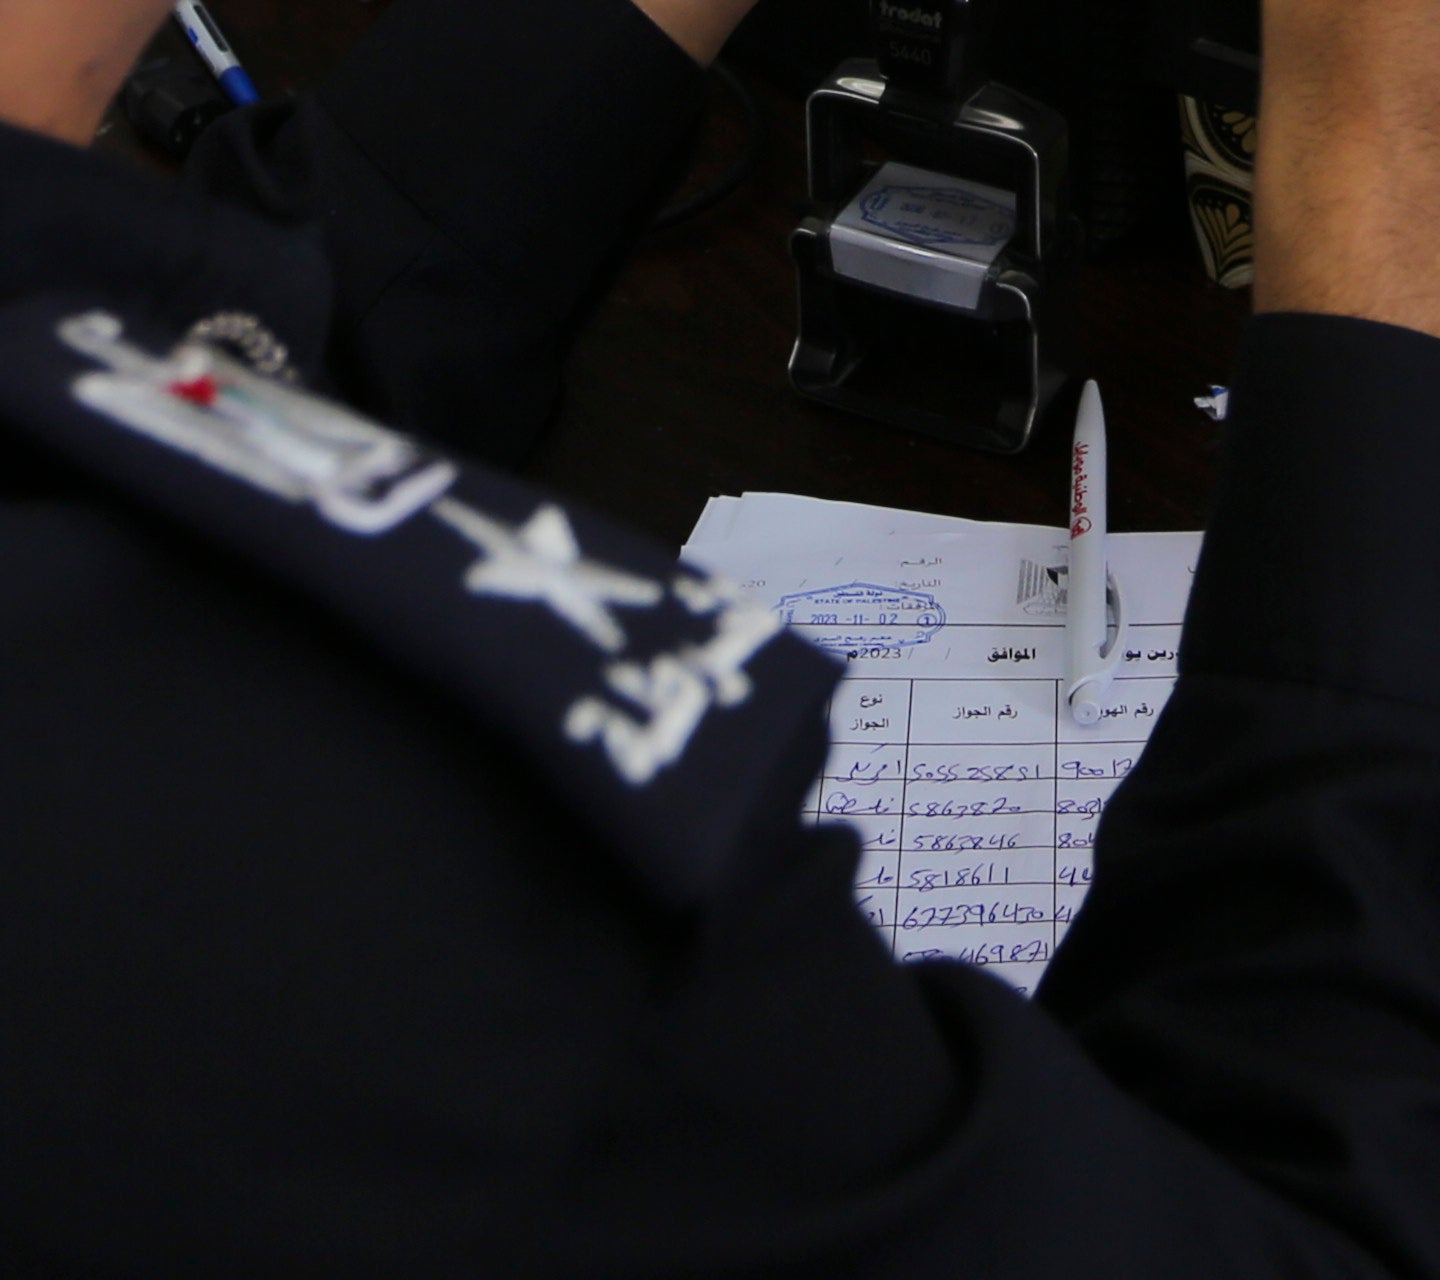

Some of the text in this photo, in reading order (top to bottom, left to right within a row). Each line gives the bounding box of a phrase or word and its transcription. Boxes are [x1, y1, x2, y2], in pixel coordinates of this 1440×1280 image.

[879, 0, 942, 29] trodat
[811, 614, 838, 624] 2023
[987, 647, 1036, 662] الموافق
[860, 694, 883, 708] نوع
[952, 705, 1018, 719] رقم الجواز
[1134, 704, 1155, 719] رقم
[849, 717, 890, 731] الجواز
